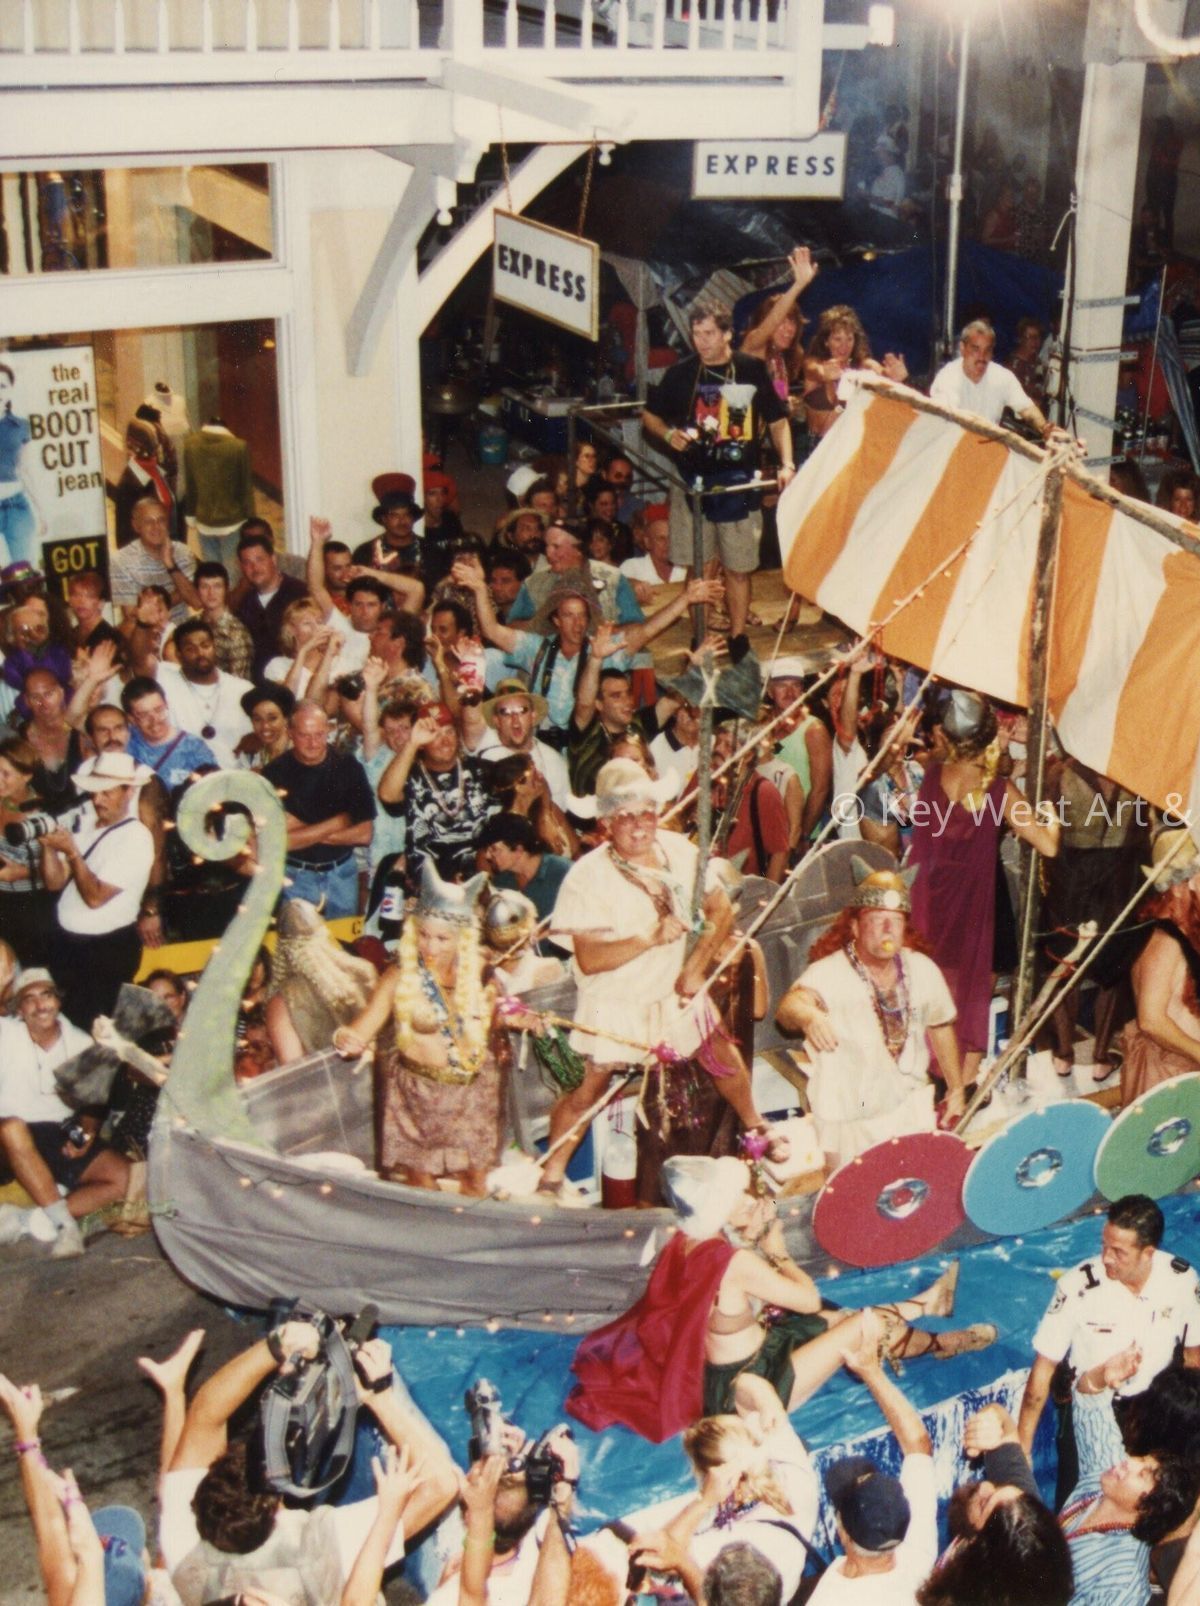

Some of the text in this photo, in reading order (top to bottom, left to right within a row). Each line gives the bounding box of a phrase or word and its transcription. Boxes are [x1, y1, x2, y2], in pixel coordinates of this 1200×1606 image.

[706, 154, 836, 176] EXPRESS
[499, 244, 586, 302] EXPRESS
[52, 363, 81, 383] the
[48, 383, 90, 406] real
[29, 408, 97, 440] BOOT
[42, 441, 91, 470] CUT
[57, 470, 103, 497] jean
[52, 542, 99, 573] GOT
